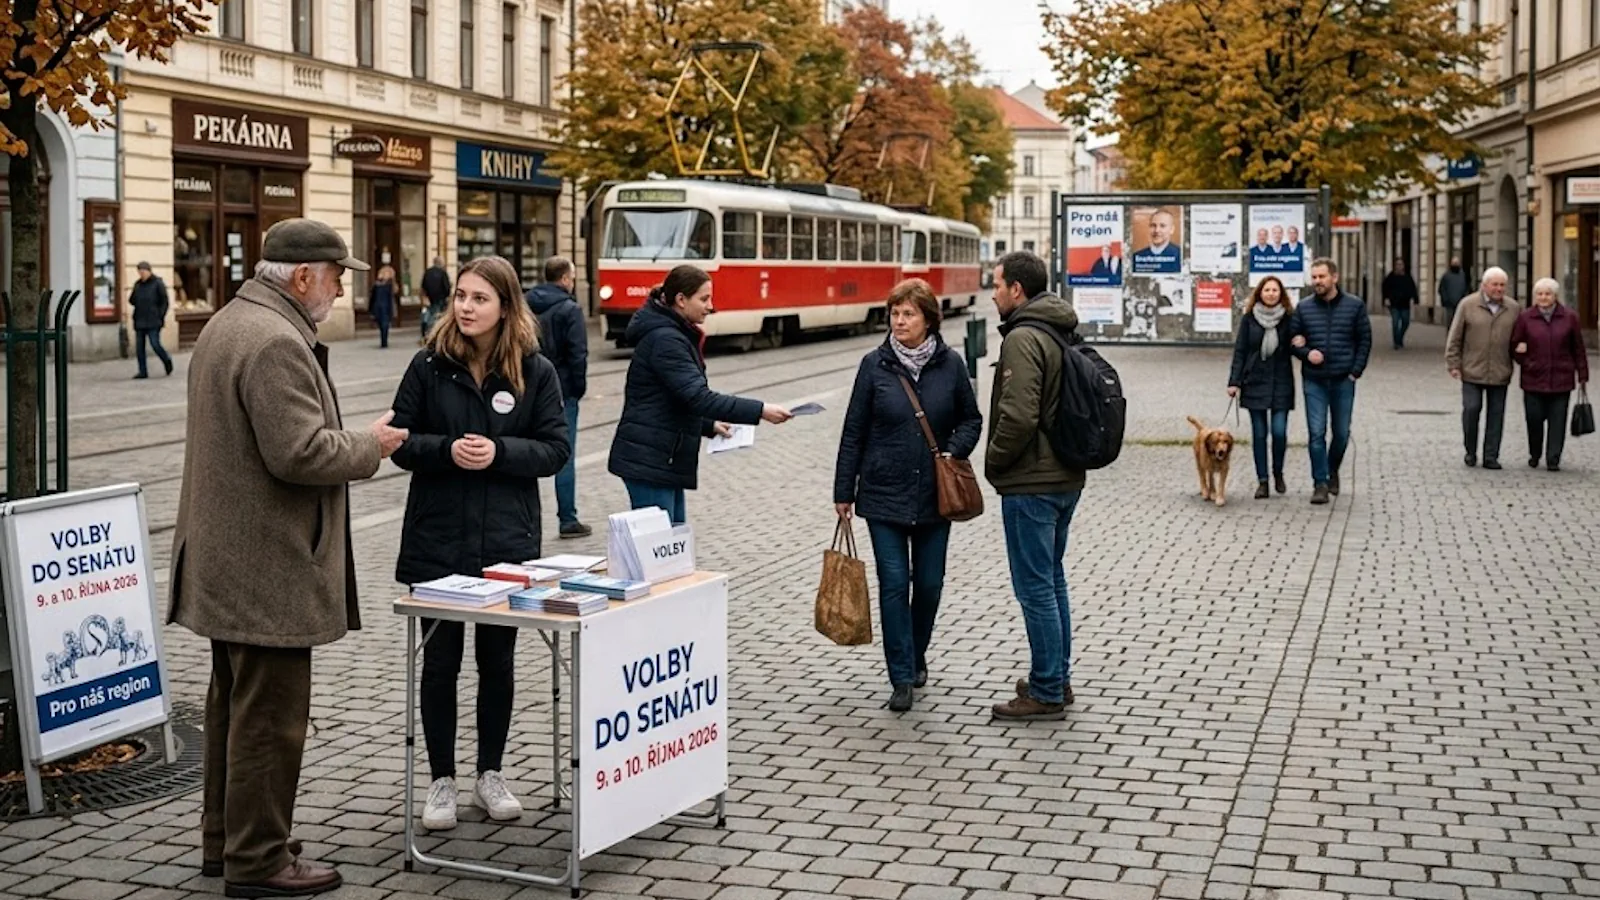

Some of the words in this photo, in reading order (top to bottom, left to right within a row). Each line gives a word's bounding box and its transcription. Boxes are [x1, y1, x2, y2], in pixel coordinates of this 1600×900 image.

[193, 114, 293, 150] PEKÁRNA
[481, 149, 534, 180] KNIHY
[1071, 211, 1093, 222] Pro
[1071, 224, 1112, 237] region
[50, 521, 111, 551] VOLBY
[652, 540, 686, 559] VOLBY
[32, 560, 61, 584] DO
[67, 545, 135, 577] SENÁTU
[37, 594, 49, 608] 9.
[51, 594, 59, 605] a
[61, 588, 77, 602] 10.
[79, 580, 111, 598] ŘÍJNA
[113, 574, 138, 591] 2026
[622, 641, 695, 694] VOLBY
[49, 699, 77, 718] Pro
[107, 676, 151, 701] region
[595, 710, 630, 751] DO
[637, 676, 718, 733] SENÁTU
[596, 770, 609, 790] 9.
[613, 767, 622, 783] a
[625, 756, 644, 778] 10.
[647, 739, 685, 769] ŘÍJNA
[688, 722, 718, 751] 2026
